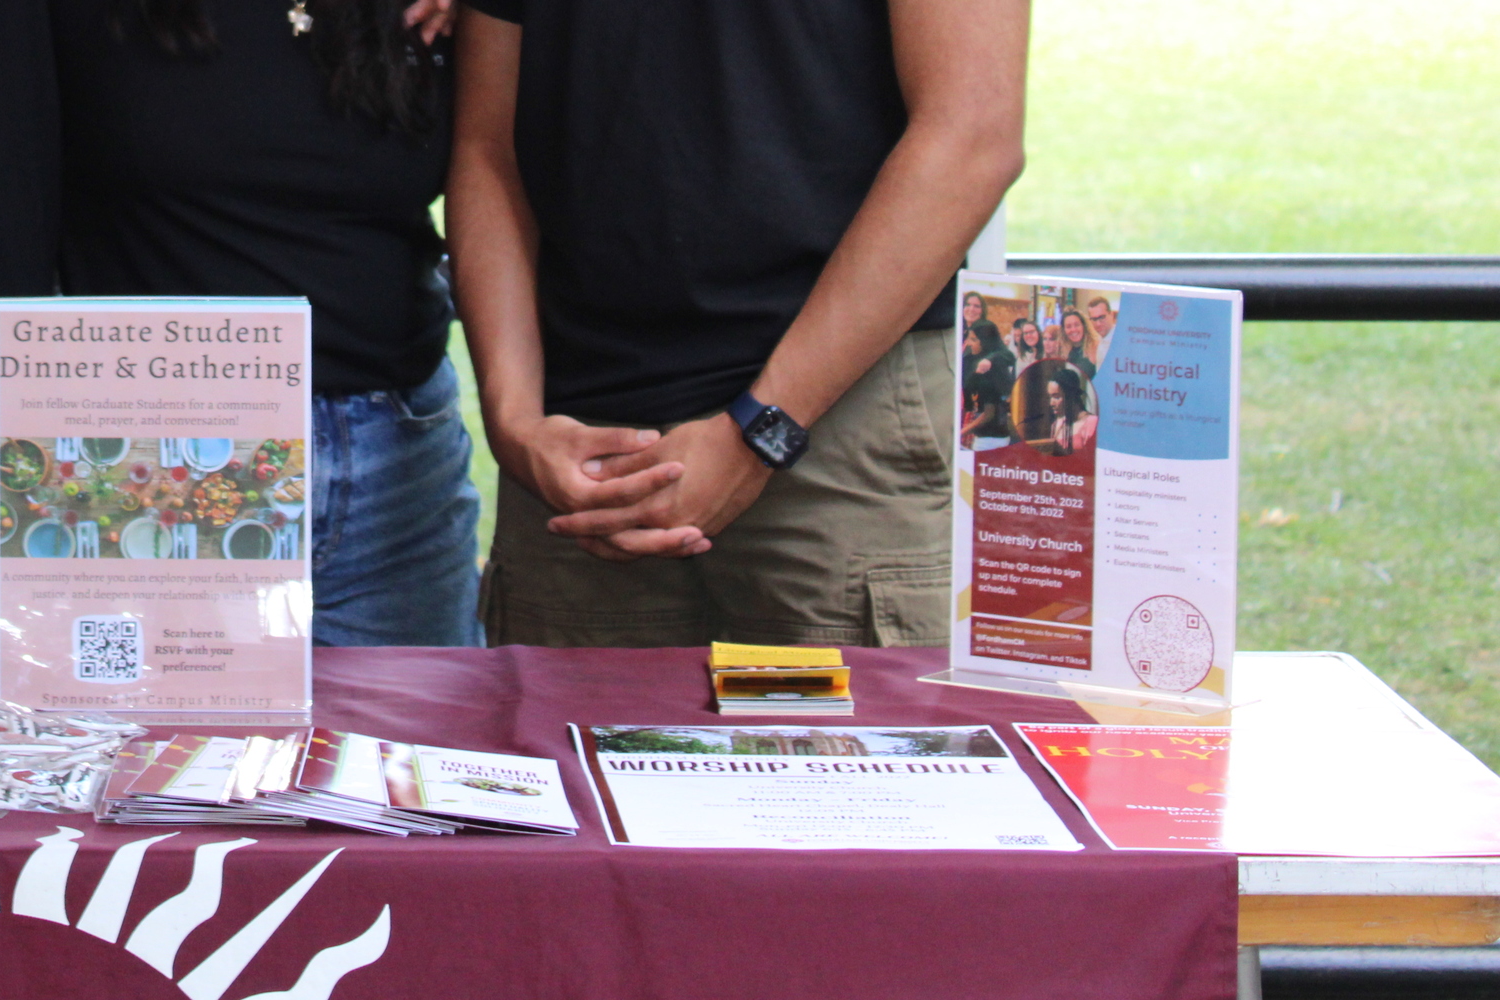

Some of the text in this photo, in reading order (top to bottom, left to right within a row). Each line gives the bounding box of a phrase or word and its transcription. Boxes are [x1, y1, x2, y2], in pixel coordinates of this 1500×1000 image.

[13, 318, 283, 343] Graduate Student
[0, 354, 302, 387] Dinner & Gathering
[1114, 357, 1200, 381] Liturgical
[1114, 381, 1188, 407] Ministry
[20, 398, 281, 413] Join fellow Graduate Students for a community
[65, 414, 95, 426] meal,
[141, 414, 161, 426] and
[164, 415, 240, 426] conversation!
[979, 463, 1084, 486] Training Dates
[1104, 467, 1181, 483] Liturgical Roles
[980, 488, 1032, 503] September
[1060, 497, 1084, 509] 2022
[980, 500, 1018, 513] October
[1040, 507, 1064, 518] 2022
[979, 530, 1083, 553] University Church
[979, 558, 1082, 580] Scan the QR code to sign
[74, 572, 104, 583] where
[107, 574, 126, 585] you
[128, 574, 146, 583] can
[189, 575, 211, 586] your
[978, 571, 1063, 589] up and for complete
[72, 589, 91, 600] and
[133, 592, 156, 602] your
[163, 628, 225, 638] Scan here to
[154, 645, 234, 658] RSVP with your
[162, 662, 226, 674] preferences!
[43, 693, 118, 705] Sponsored
[146, 695, 203, 707] Campus
[210, 696, 273, 708] Ministry
[1044, 745, 1214, 760] HOLY
[440, 760, 538, 778] TOGETHER
[440, 765, 549, 786] IN MISSION
[609, 760, 1006, 775] WORSHIP SCHEDULE
